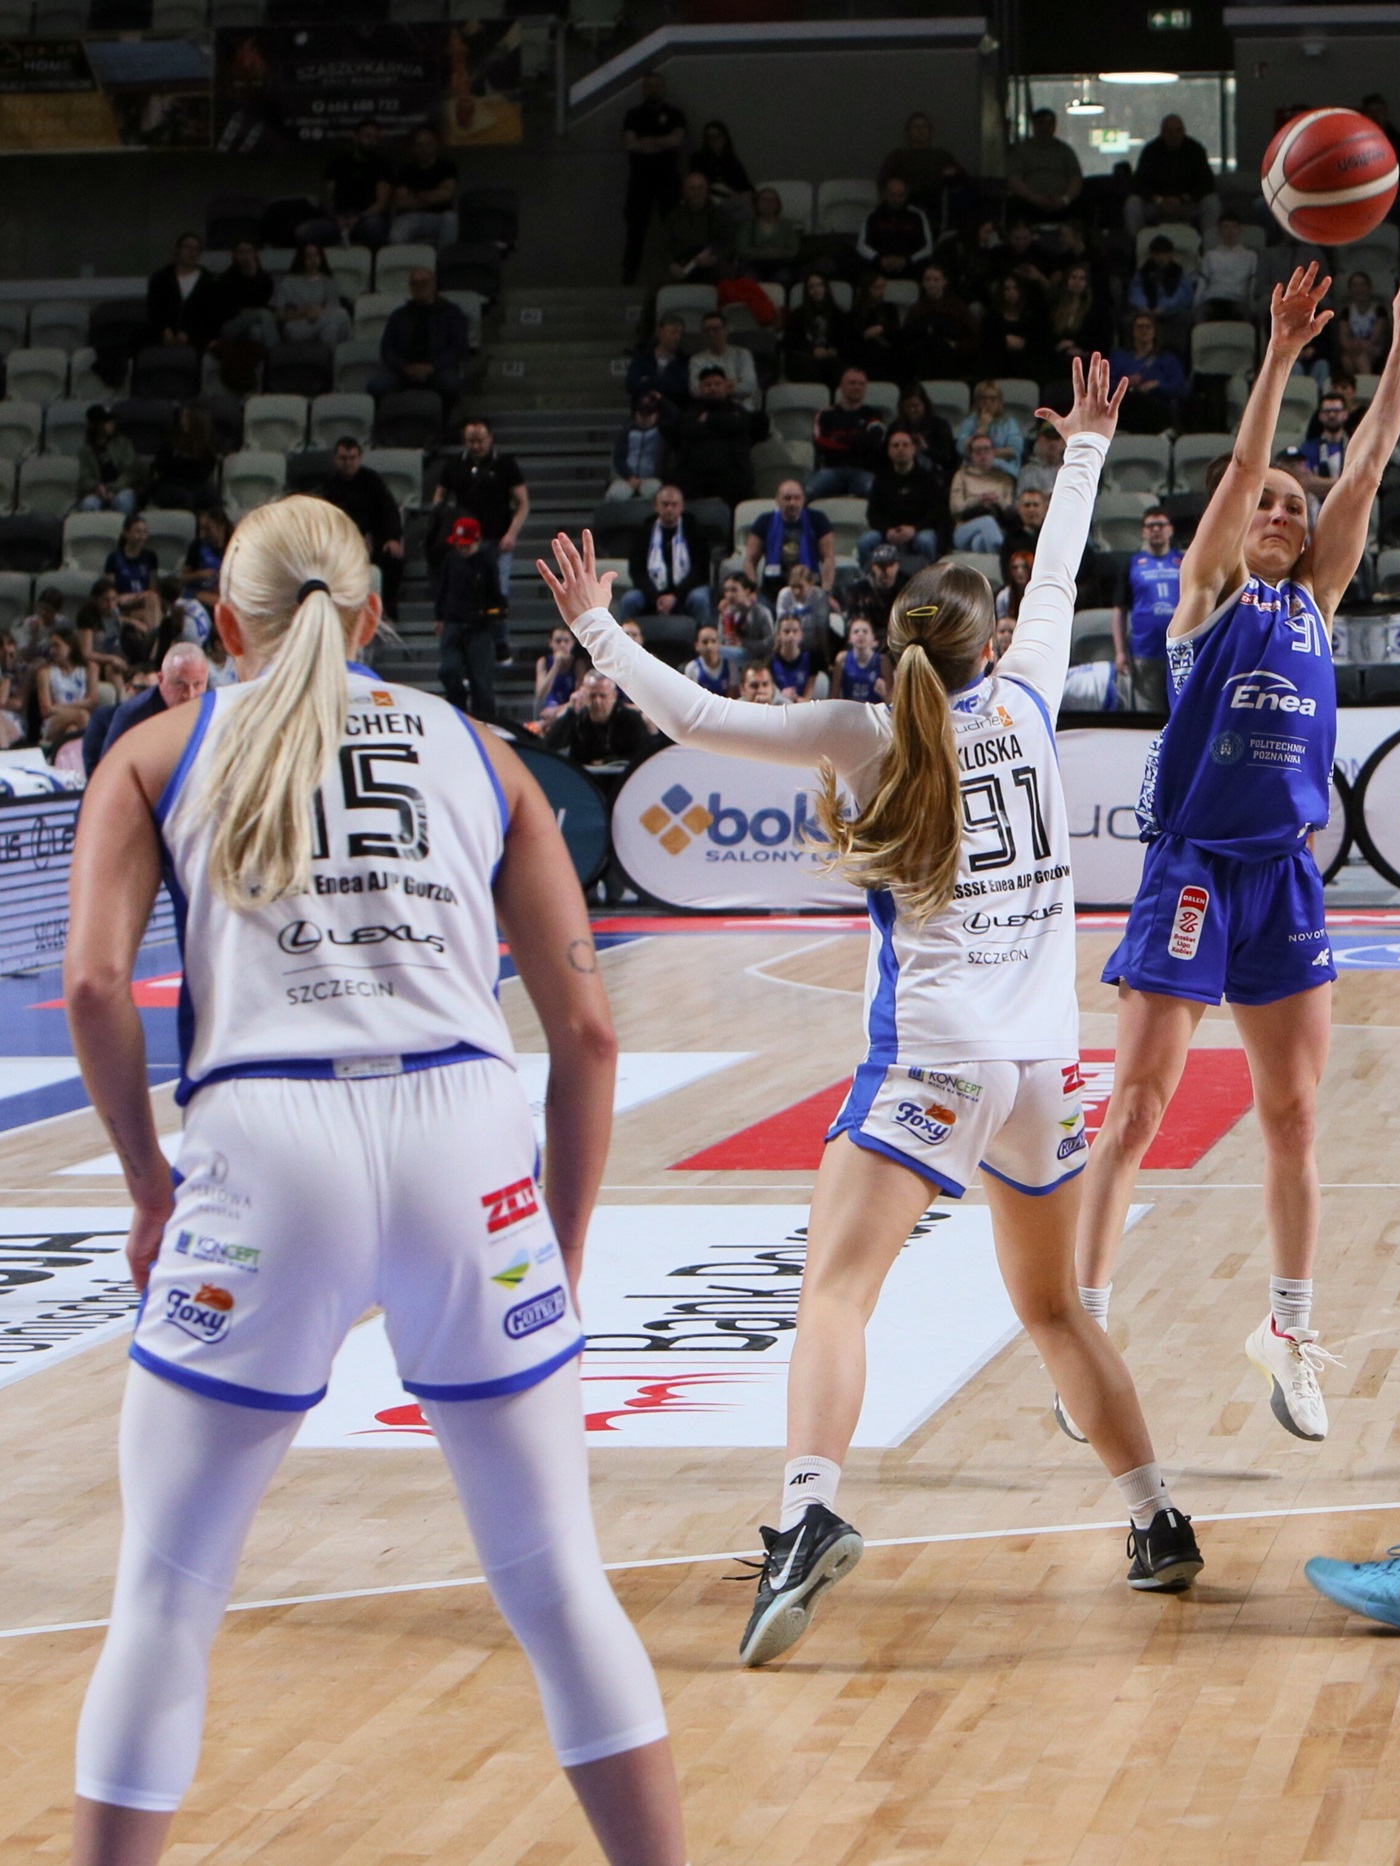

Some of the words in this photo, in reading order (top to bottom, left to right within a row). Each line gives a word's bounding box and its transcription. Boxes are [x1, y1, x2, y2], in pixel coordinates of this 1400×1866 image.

[1284, 612, 1321, 657] 91
[1229, 685, 1317, 717] Enea
[960, 766, 1052, 873] 91
[705, 850, 804, 863] SALONY
[314, 874, 364, 895] Enea
[1182, 894, 1206, 905] ORLEN
[1311, 948, 1330, 966] 4F
[286, 979, 395, 1006] SZCZECIN
[928, 1071, 984, 1097] KONCEPT
[895, 1101, 950, 1141] Foxy
[166, 1287, 228, 1337] Foxy
